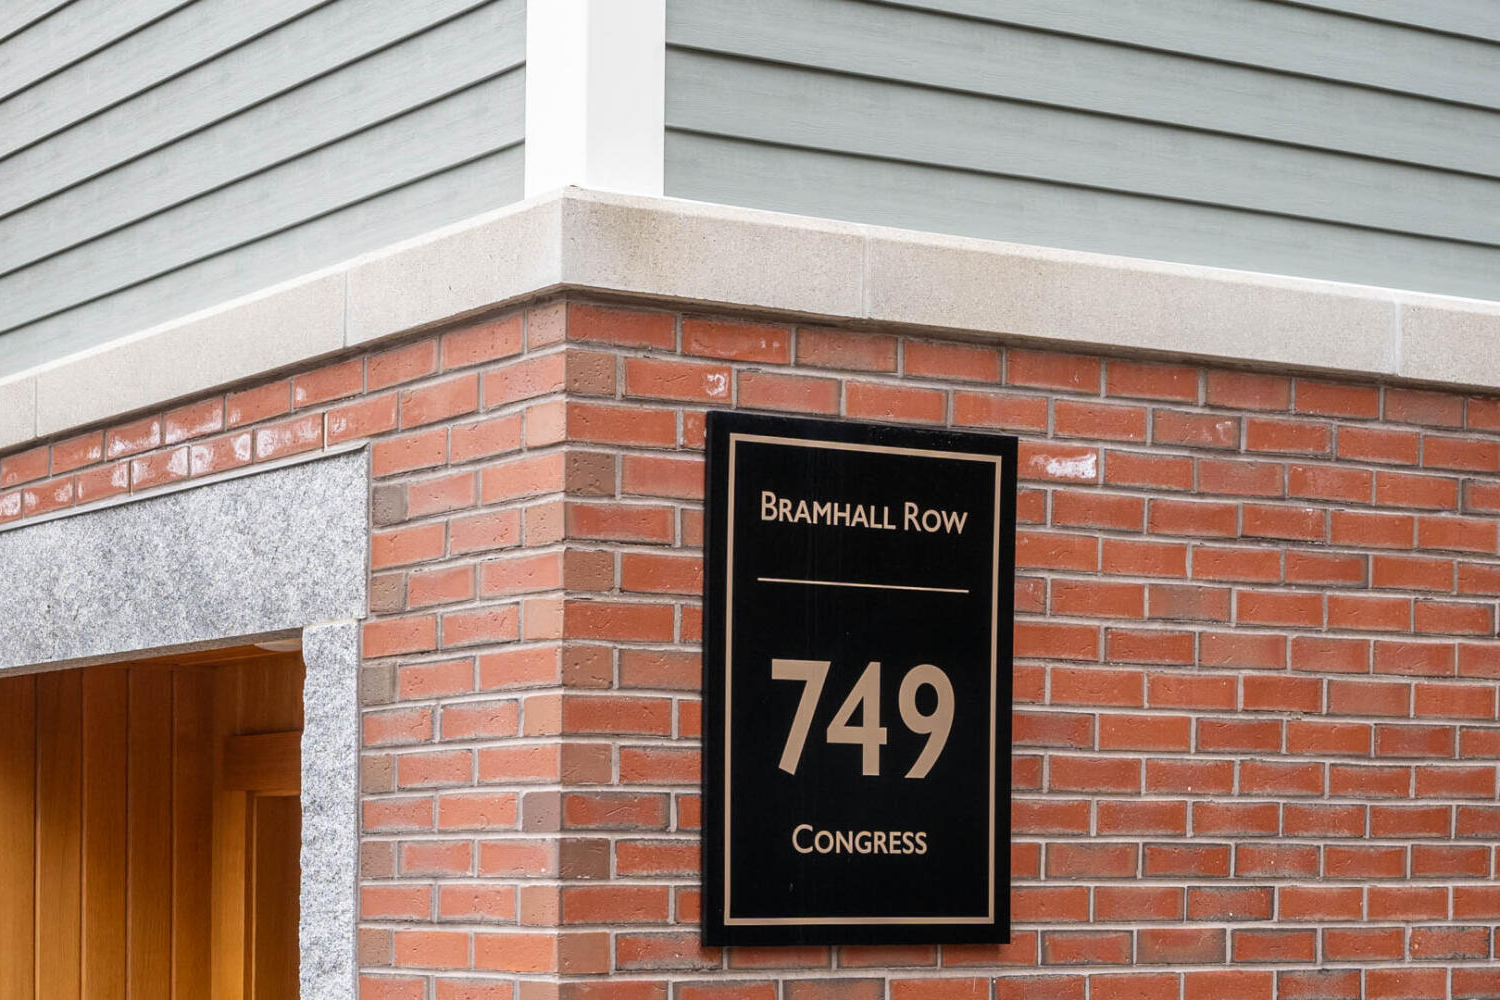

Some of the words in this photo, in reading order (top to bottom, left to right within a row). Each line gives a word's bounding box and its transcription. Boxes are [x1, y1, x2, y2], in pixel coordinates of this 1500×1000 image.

[761, 491, 896, 530] BRAMHALL
[903, 502, 968, 535] ROW
[771, 658, 955, 779] 749
[791, 824, 928, 855] CONGRESS
